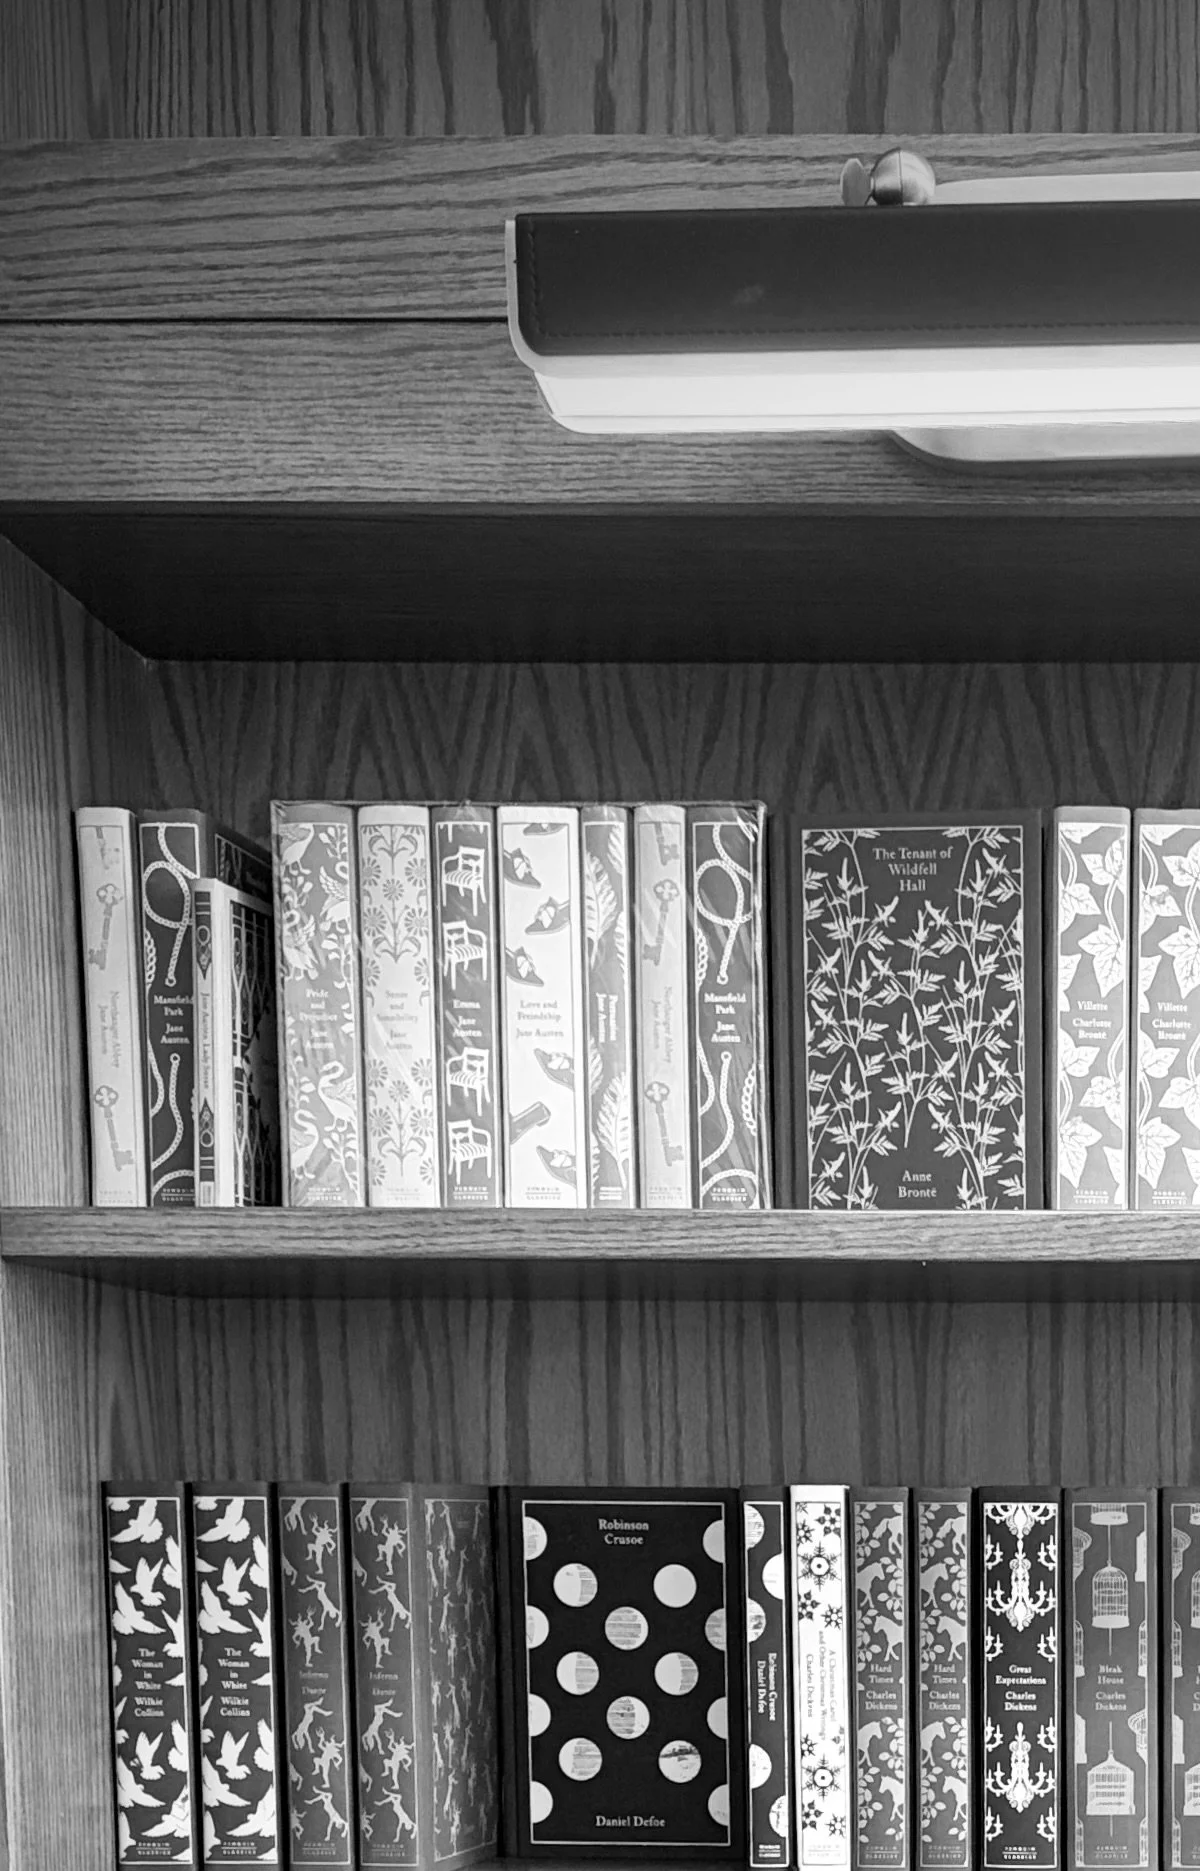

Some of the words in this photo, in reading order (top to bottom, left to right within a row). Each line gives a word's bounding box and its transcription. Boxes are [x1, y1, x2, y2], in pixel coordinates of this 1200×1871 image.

[872, 847, 896, 860] The
[898, 847, 937, 859] Tenant
[940, 845, 954, 859] of
[888, 862, 937, 875] Wildfell
[900, 879, 926, 892] Hall
[154, 995, 194, 1004] Mansfield
[704, 993, 746, 1003] Mansfield
[453, 1000, 480, 1008] Emma
[1078, 1001, 1108, 1011] Villette
[164, 1006, 183, 1016] Park
[715, 1004, 736, 1014] Park
[459, 1016, 476, 1027] Jane
[1072, 1018, 1111, 1028] Charlotte
[166, 1023, 183, 1034] Jane
[716, 1021, 736, 1032] Jane
[452, 1028, 482, 1037] Austen
[161, 1035, 190, 1044] Austen
[711, 1033, 741, 1042] Austen
[902, 1170, 931, 1182] Anne
[599, 1518, 649, 1531] Robinson
[604, 1533, 643, 1545] Crusoe
[139, 1648, 155, 1657] The
[224, 1647, 241, 1656] The
[132, 1659, 163, 1668] Woman
[218, 1659, 250, 1668] Woman
[1009, 1664, 1031, 1673] Great
[144, 1670, 152, 1678] in
[230, 1670, 238, 1678] in
[995, 1675, 1047, 1686] Expectations
[136, 1681, 161, 1690] White
[221, 1681, 247, 1690] White
[221, 1696, 248, 1705] Wilkie
[1005, 1691, 1036, 1701] Charles
[135, 1697, 163, 1705] Wilkie
[1004, 1702, 1037, 1711] Dickens
[135, 1708, 164, 1717] Collins
[220, 1708, 250, 1717] Collins
[596, 1815, 630, 1827] Daniel
[633, 1815, 665, 1827] Defoe
